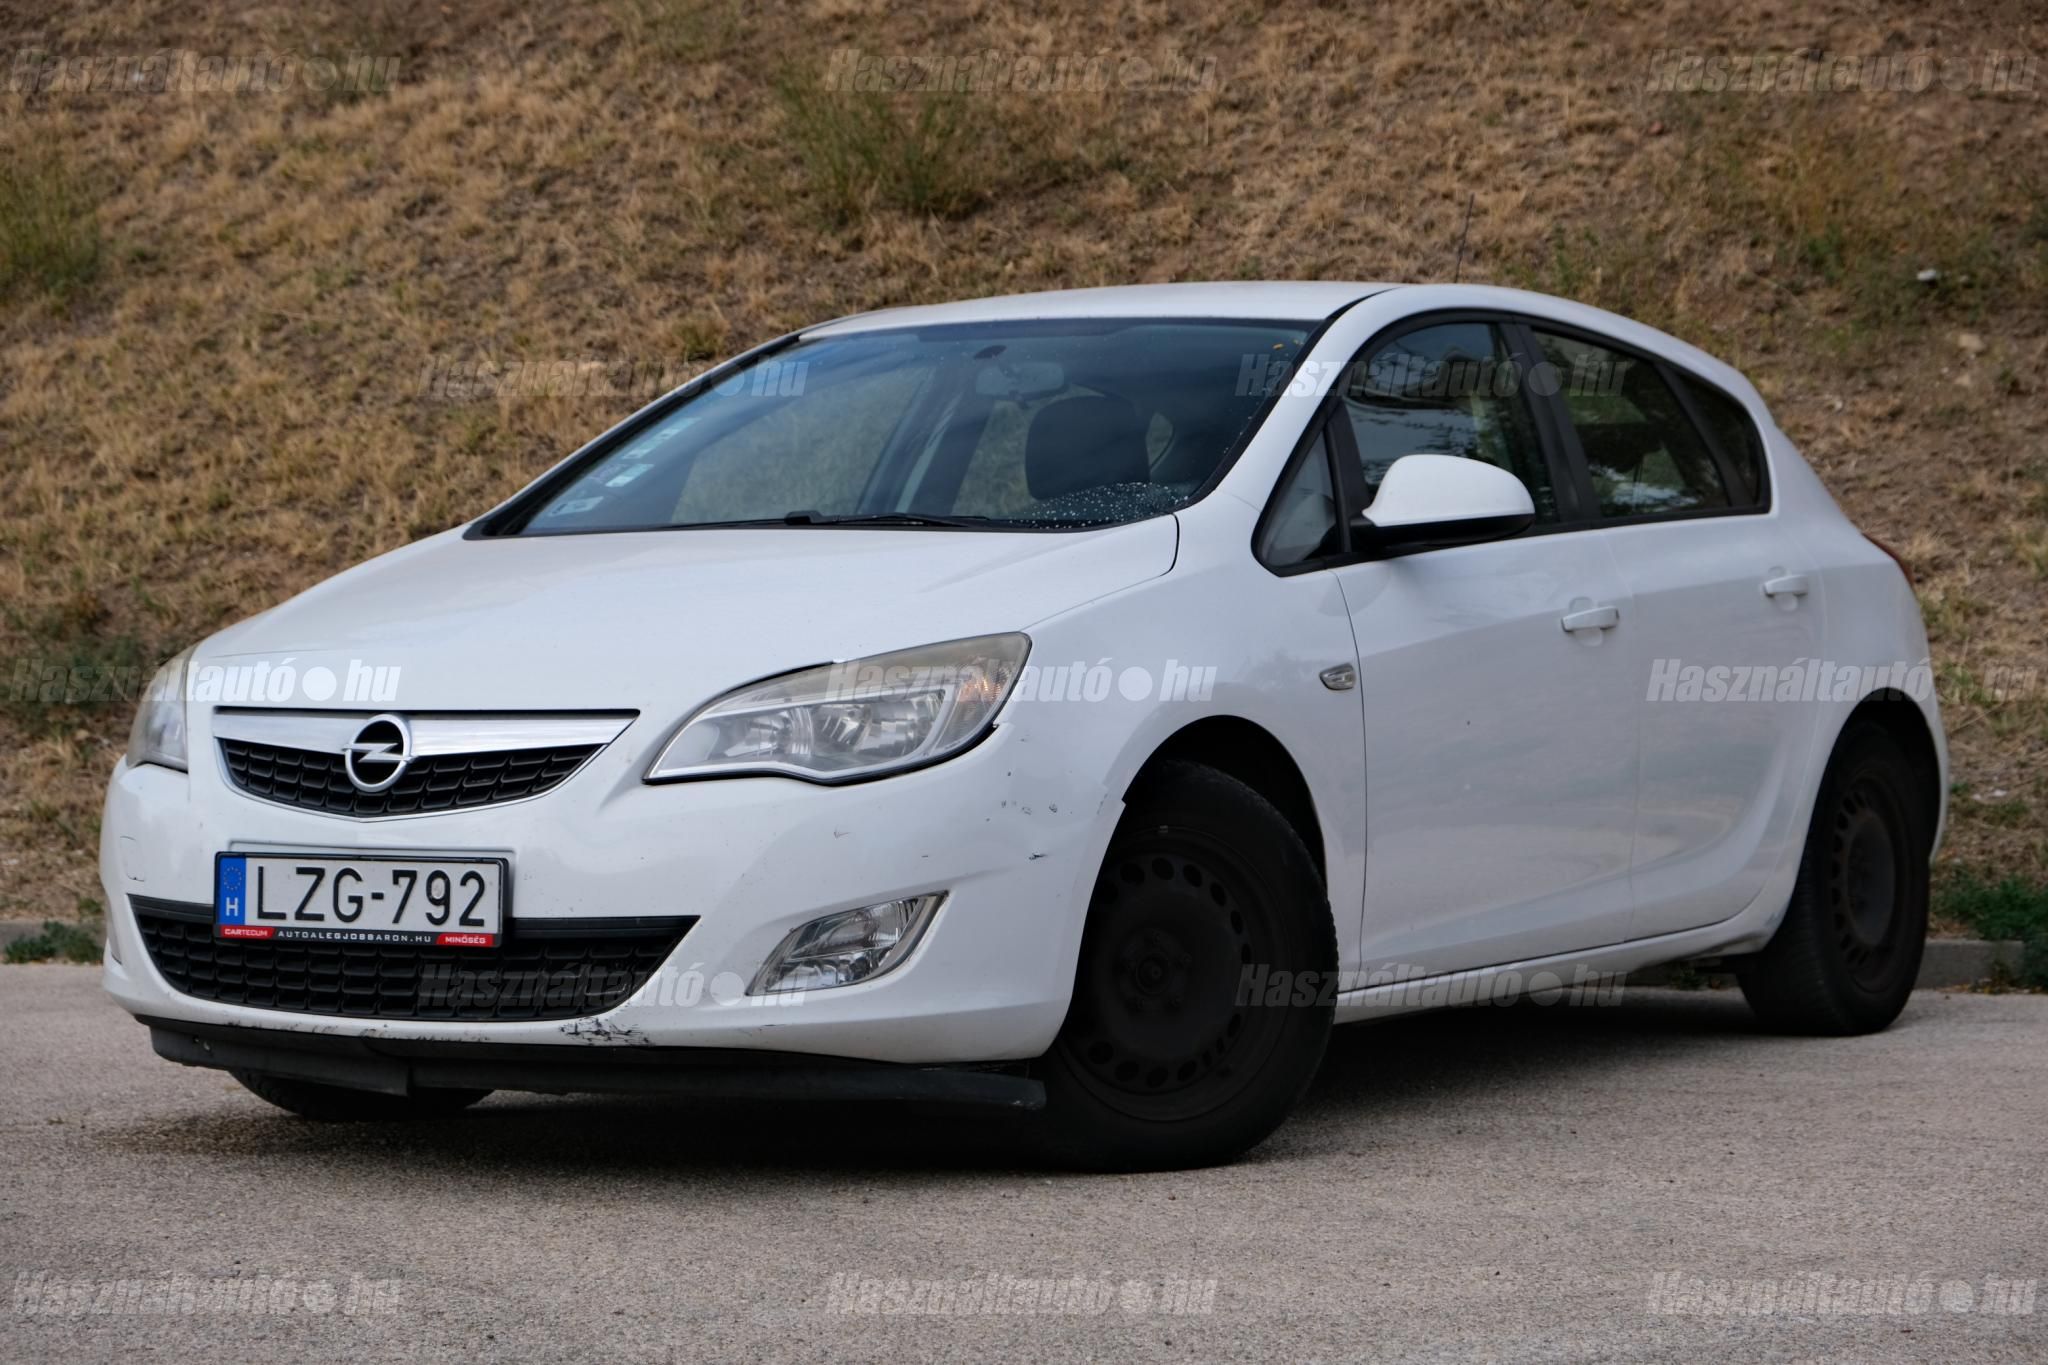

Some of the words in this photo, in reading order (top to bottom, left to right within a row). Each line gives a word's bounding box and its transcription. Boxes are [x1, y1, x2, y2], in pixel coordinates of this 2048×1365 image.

[226, 897, 239, 917] H
[257, 865, 486, 927] LZG-792
[278, 931, 431, 943] AUTOALEGJOBBARON.HU
